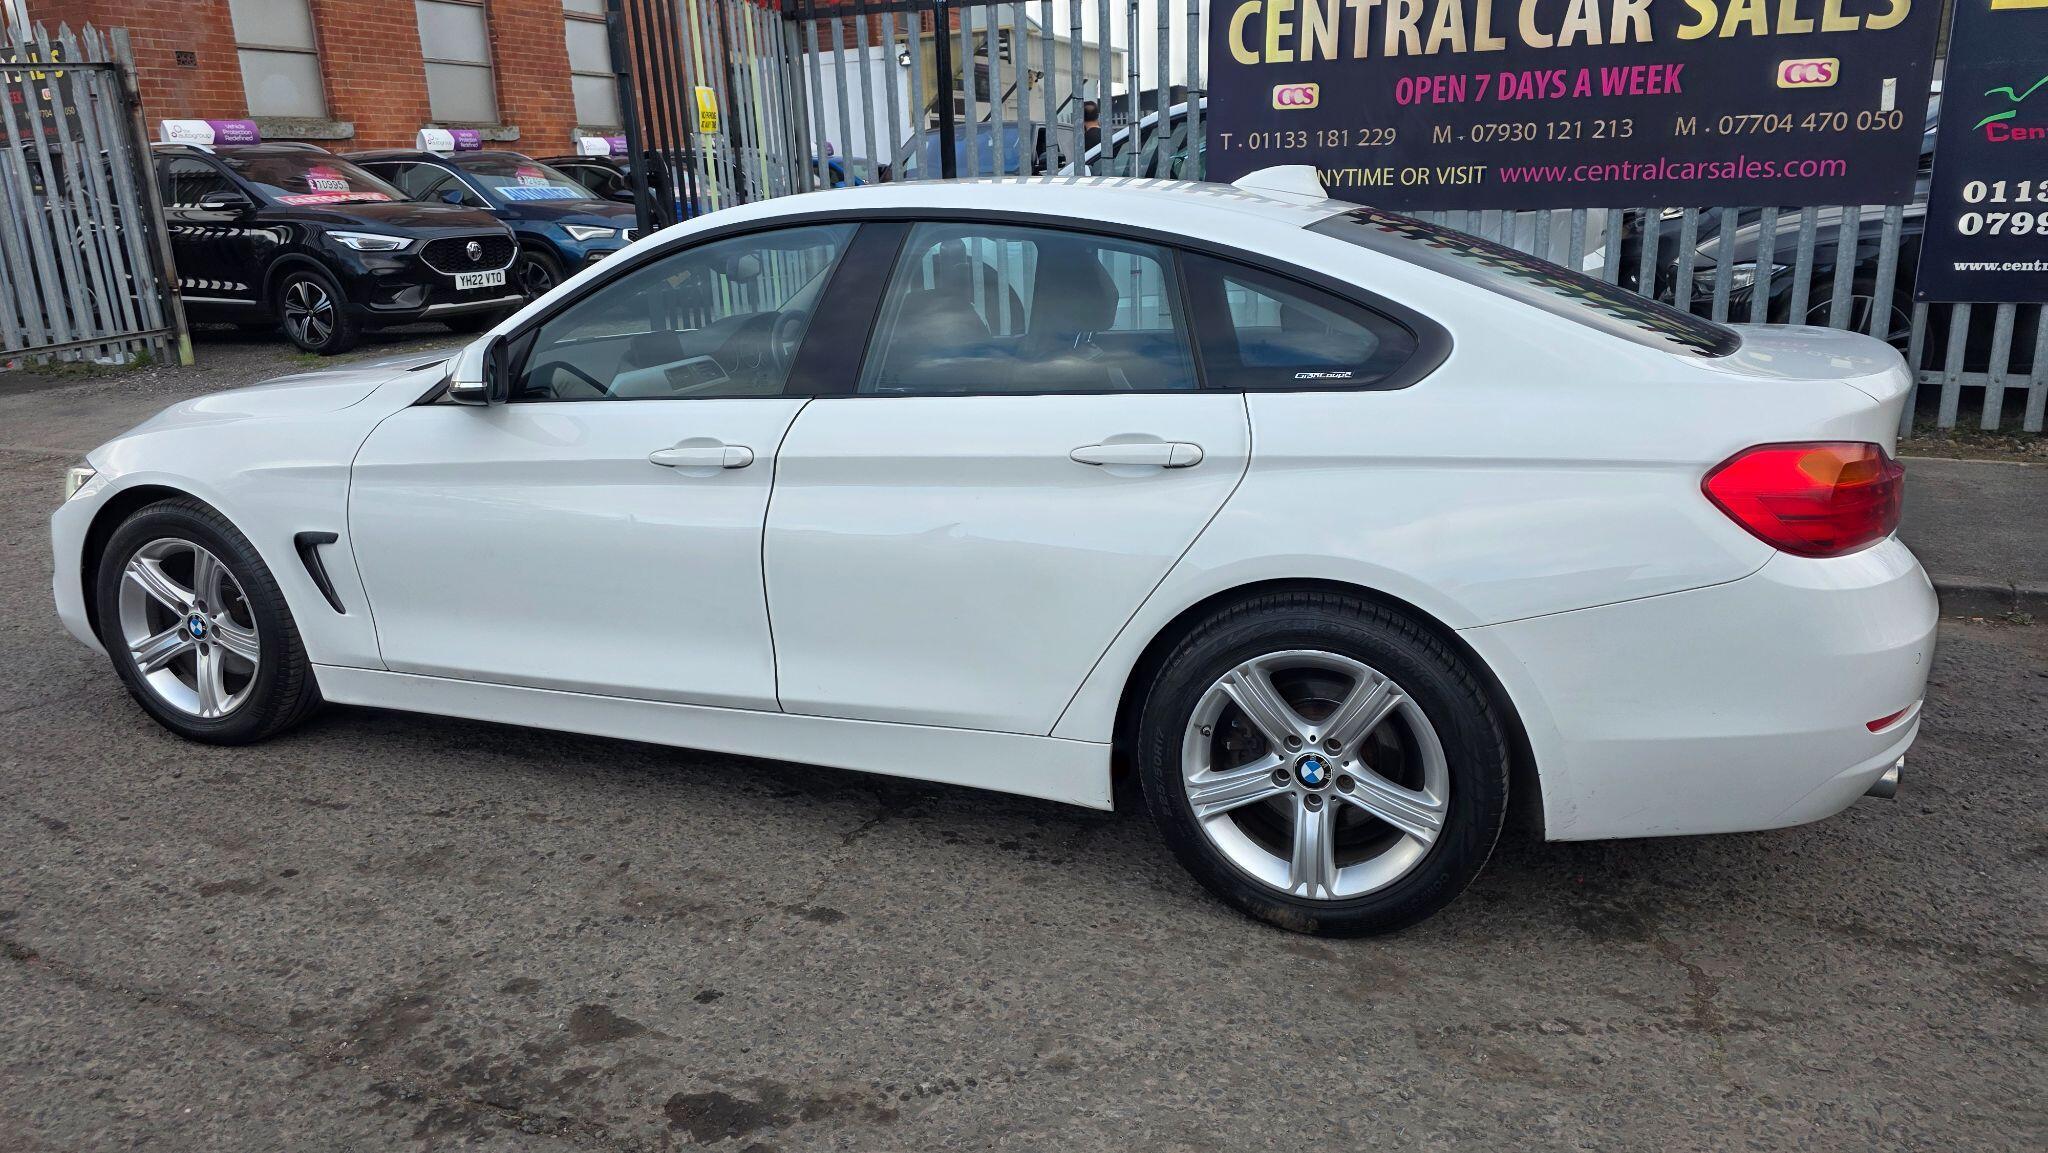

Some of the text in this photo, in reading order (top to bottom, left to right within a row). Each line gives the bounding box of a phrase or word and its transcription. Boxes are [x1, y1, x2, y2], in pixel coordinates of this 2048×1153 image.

[1229, 0, 1506, 65] CENTRAL
[1518, 0, 1653, 49] CAR
[1396, 63, 1685, 106] OPEN 7 DAYS A WEEK
[1471, 122, 1537, 143] 07930
[1547, 120, 1582, 140] 121
[1591, 118, 1634, 139] 213
[1718, 113, 1794, 136] 07704
[1800, 111, 1848, 133] 470
[1856, 109, 1904, 132] 050
[1986, 121, 2048, 142] Cen
[1249, 131, 1308, 150] 01133
[1317, 129, 1348, 147] 181
[1357, 127, 1397, 147] 229
[1317, 154, 1847, 187] NYTIME OR VISIT www.centralcarsales.com
[459, 271, 502, 287] YH22 VTO
